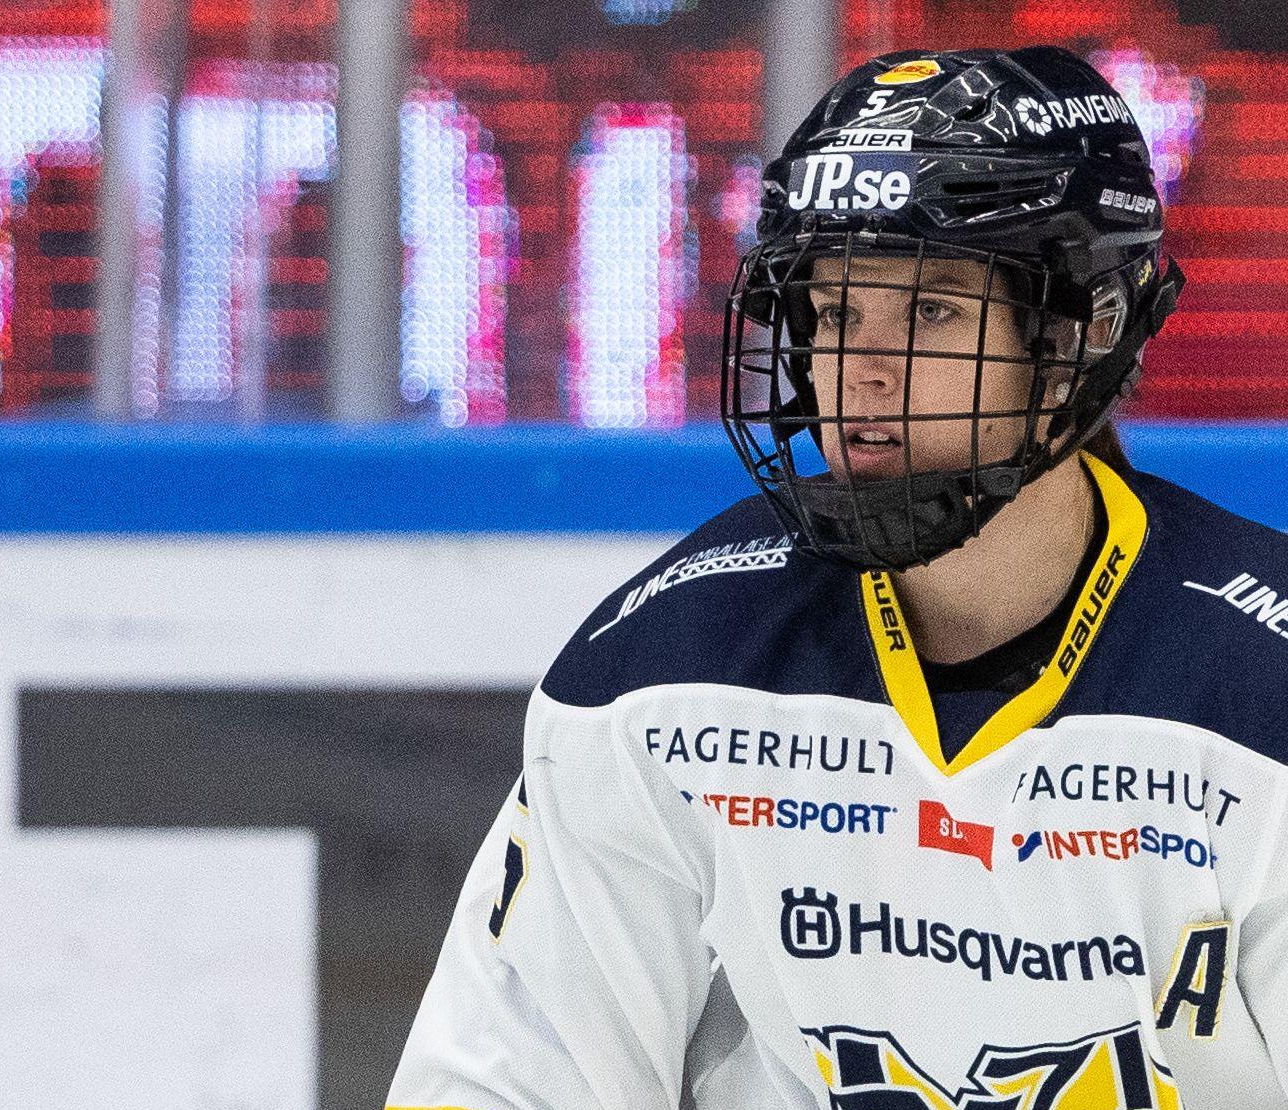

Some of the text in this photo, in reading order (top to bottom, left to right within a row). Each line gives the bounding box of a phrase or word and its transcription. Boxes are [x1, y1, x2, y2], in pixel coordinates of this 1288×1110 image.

[859, 90, 895, 117] 5
[1047, 95, 1135, 129] RAVEMA
[831, 133, 907, 148] AUER
[788, 153, 911, 210] JP.se
[1098, 188, 1157, 214] BAUER
[588, 557, 689, 642] JUNE
[869, 569, 907, 652] UER
[1057, 544, 1127, 679] BAUER
[645, 725, 895, 776] FAGERHULT
[702, 793, 891, 834] TERSPORT
[1011, 763, 1242, 827] AGERHUT
[1044, 825, 1218, 870] INTERSPO
[849, 901, 1145, 982] Husqvarna
[1156, 922, 1231, 1040] A
